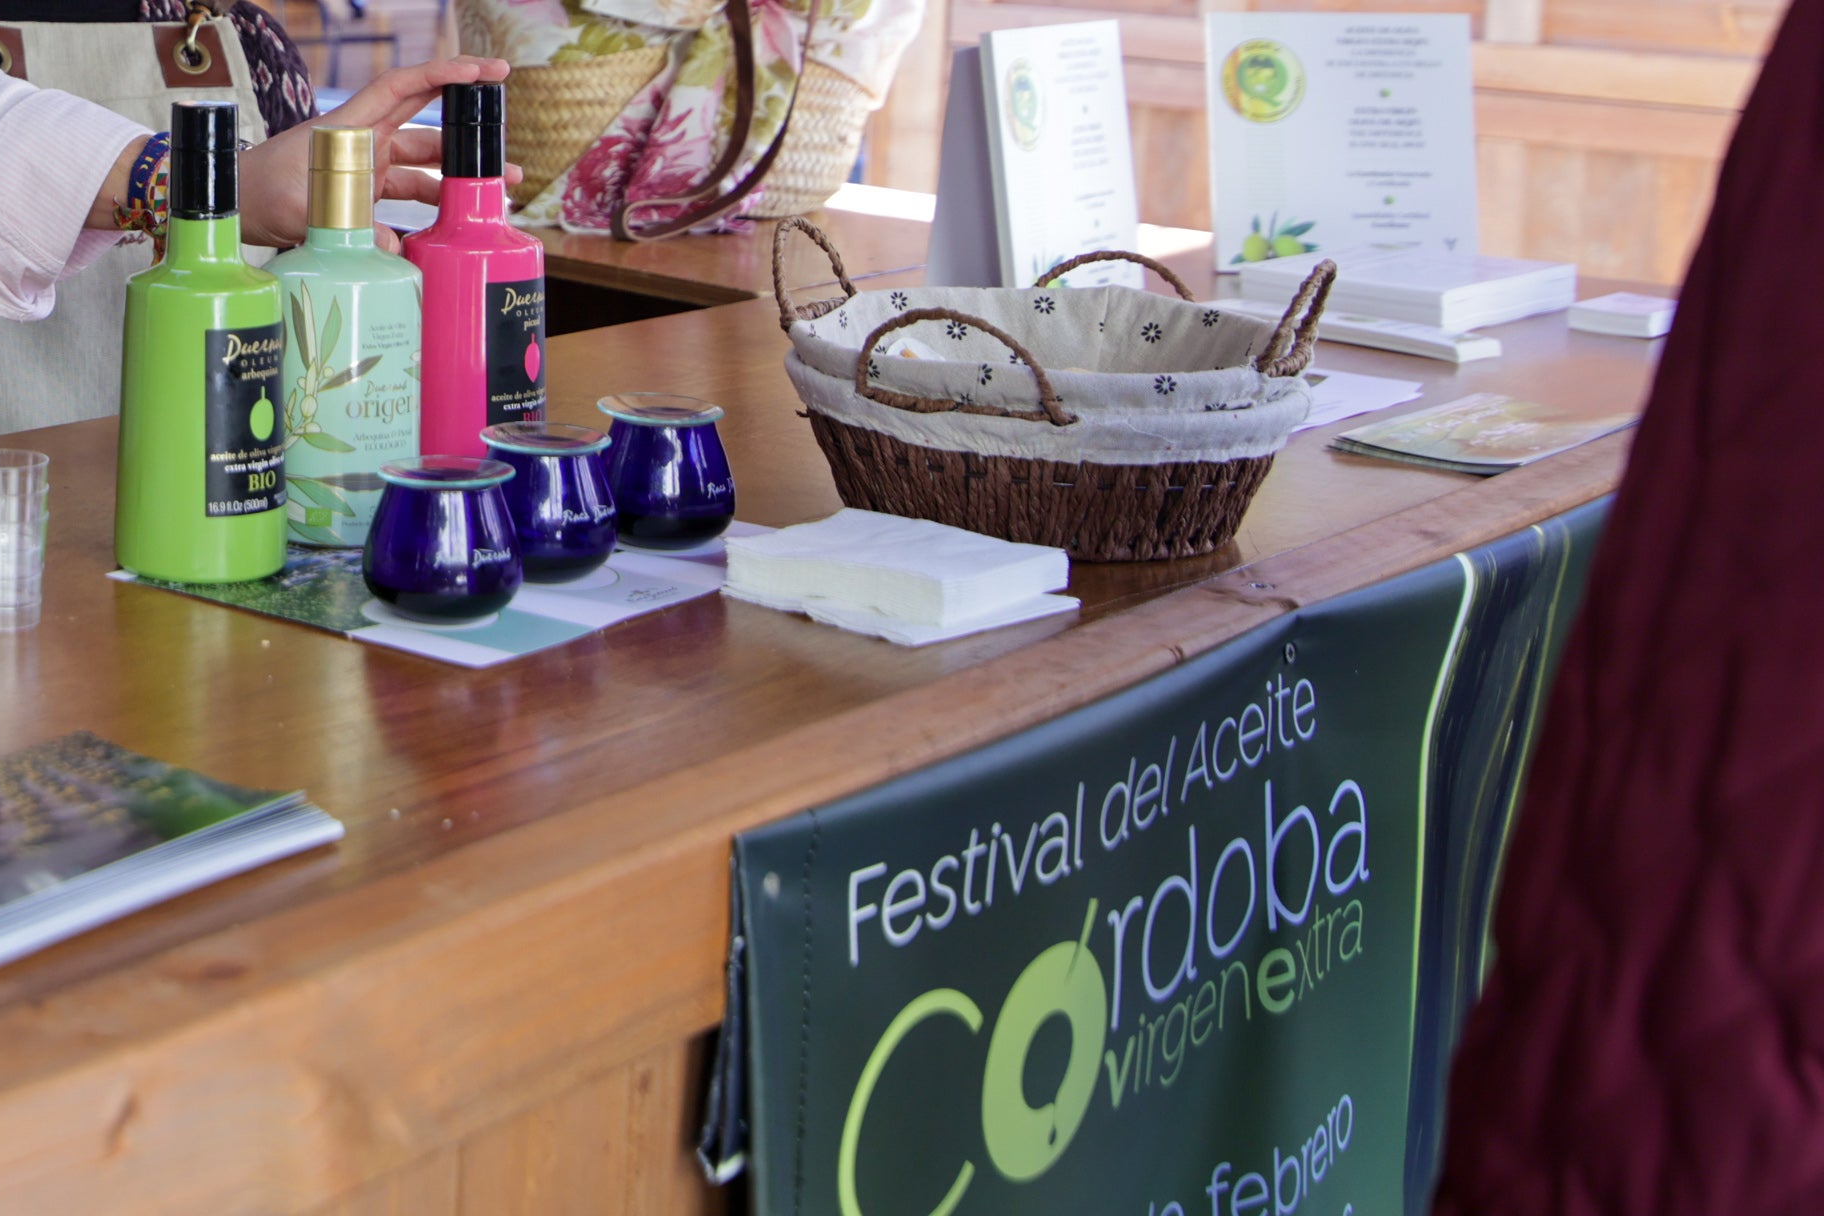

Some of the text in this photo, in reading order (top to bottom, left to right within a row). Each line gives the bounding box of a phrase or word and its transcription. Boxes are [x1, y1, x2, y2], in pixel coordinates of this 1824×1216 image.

[210, 450, 237, 463] aceite
[224, 463, 247, 475] extra
[248, 469, 276, 493] BIO
[562, 509, 590, 527] Finca
[848, 672, 1317, 968] Festival del Aceite
[1205, 1094, 1353, 1216] febrero
